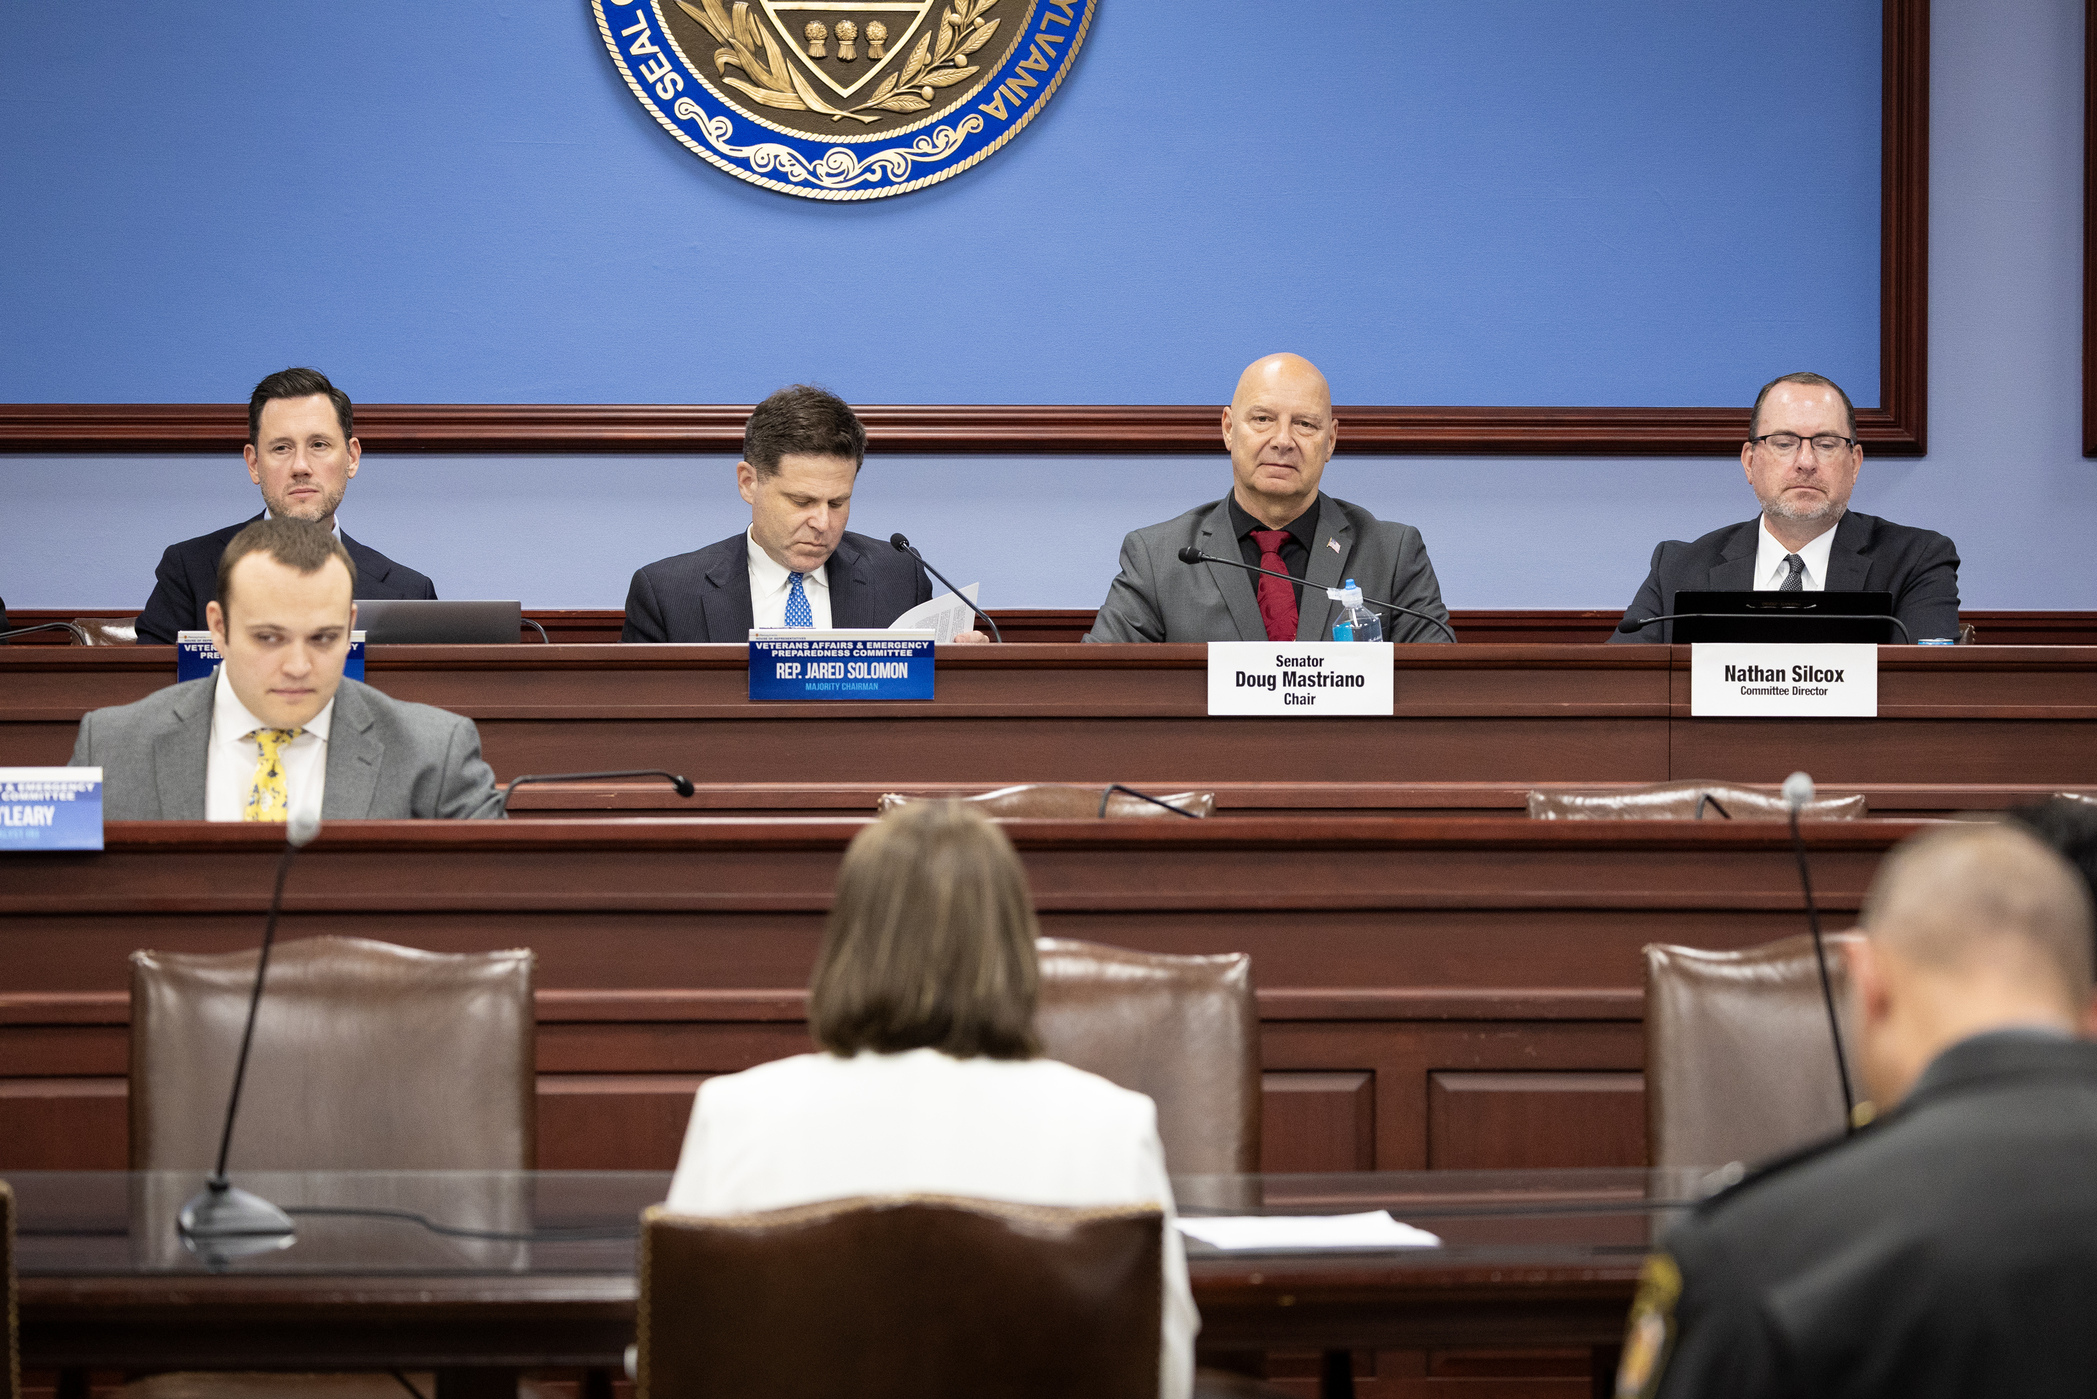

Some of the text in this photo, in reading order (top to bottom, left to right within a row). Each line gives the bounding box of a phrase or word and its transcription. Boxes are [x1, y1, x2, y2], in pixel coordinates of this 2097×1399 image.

[621, 9, 684, 100] SEAL
[755, 642, 810, 650] VETERANS
[811, 642, 854, 650] AFFAIRS
[866, 641, 929, 649] EMERGENCY
[852, 649, 913, 657] COMMITTEE
[1275, 654, 1324, 667] Senator
[776, 662, 908, 679] REP. JARED SOLOMON
[1724, 664, 1845, 682] Nathan Silcox
[805, 682, 878, 691] MAJORITY CHAIRMAN
[1235, 671, 1365, 691] Doug Mastriano
[1740, 686, 1828, 695] Committee Director
[1284, 692, 1316, 705] Chair
[1, 791, 76, 801] COMMITTEE
[0, 805, 56, 827] 'LEARY
